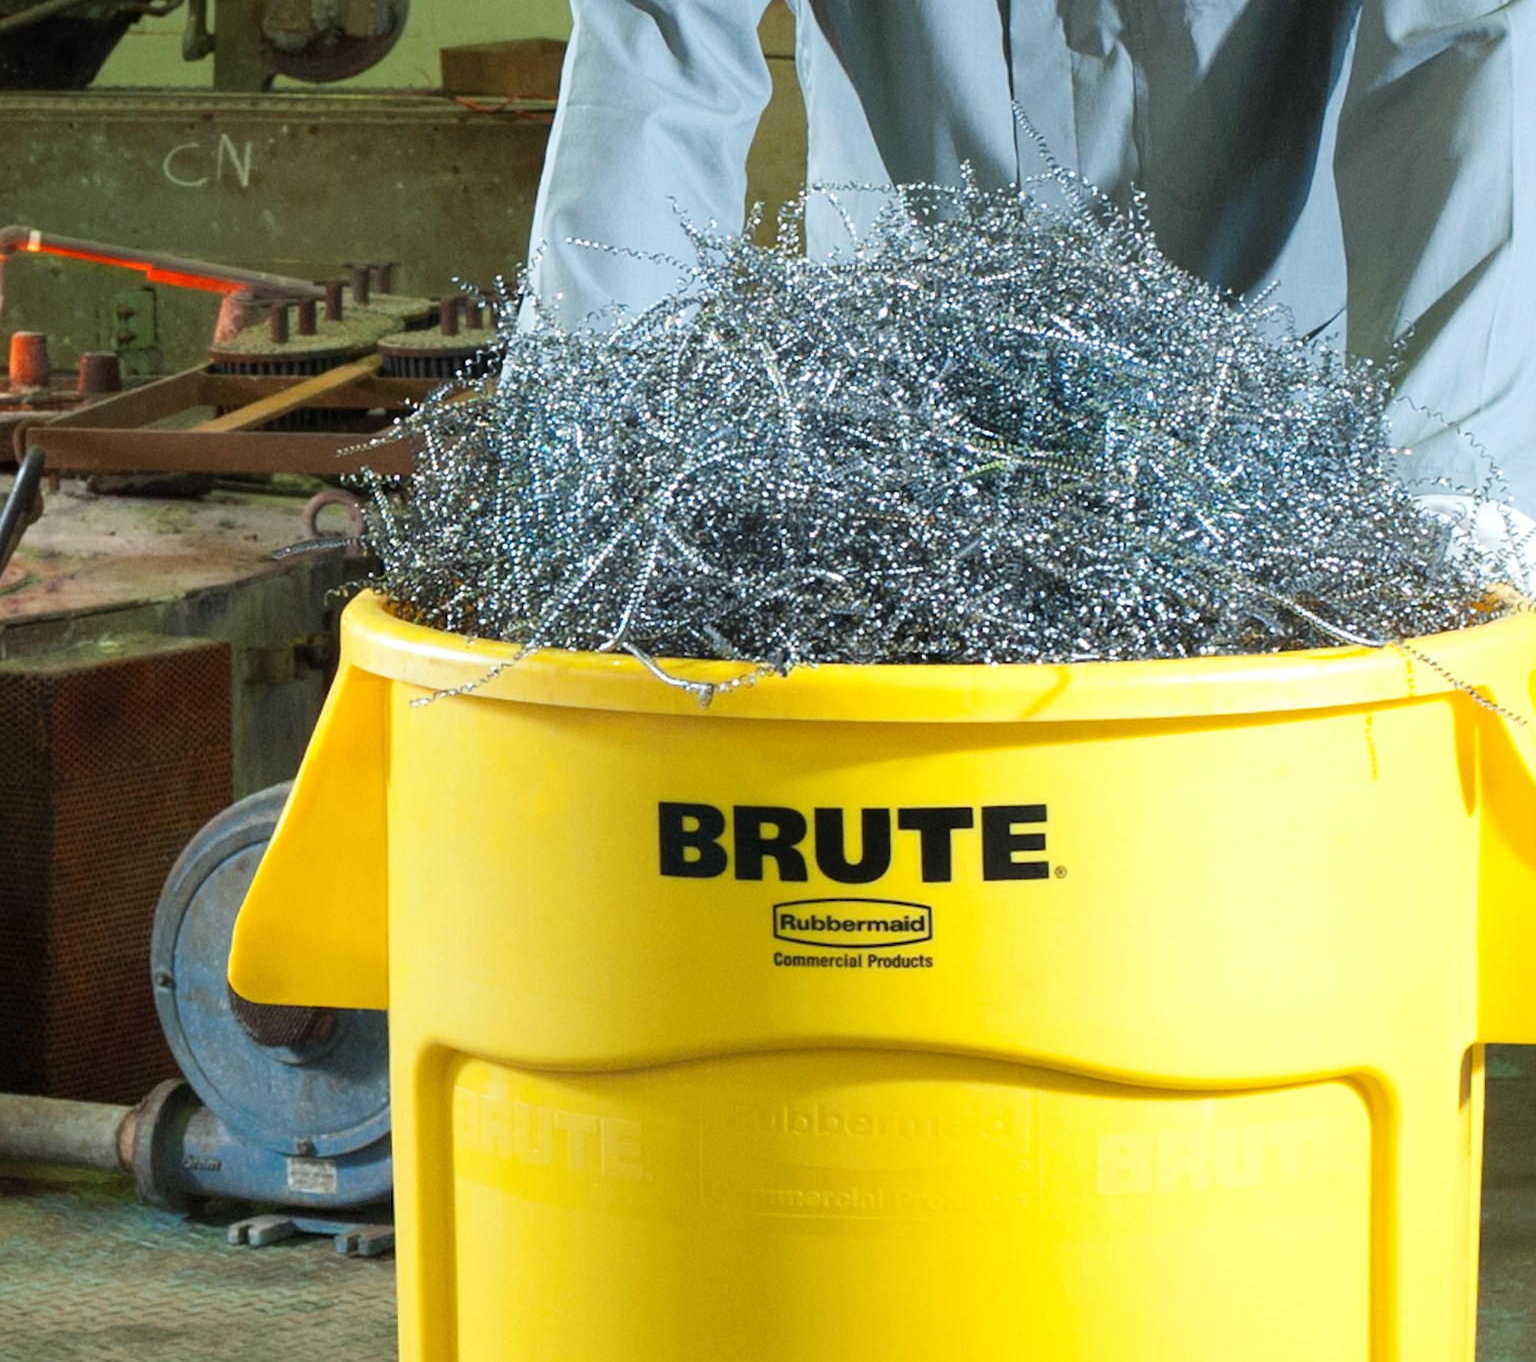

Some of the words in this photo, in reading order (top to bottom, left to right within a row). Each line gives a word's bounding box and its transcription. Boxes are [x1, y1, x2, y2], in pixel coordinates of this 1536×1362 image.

[162, 133, 253, 187] CN
[658, 801, 1050, 884] BRUTE
[780, 914, 926, 933] Rubbermaid
[773, 951, 863, 968] Commercial
[867, 952, 934, 969] Products
[728, 1102, 1013, 1136] ubbermaid
